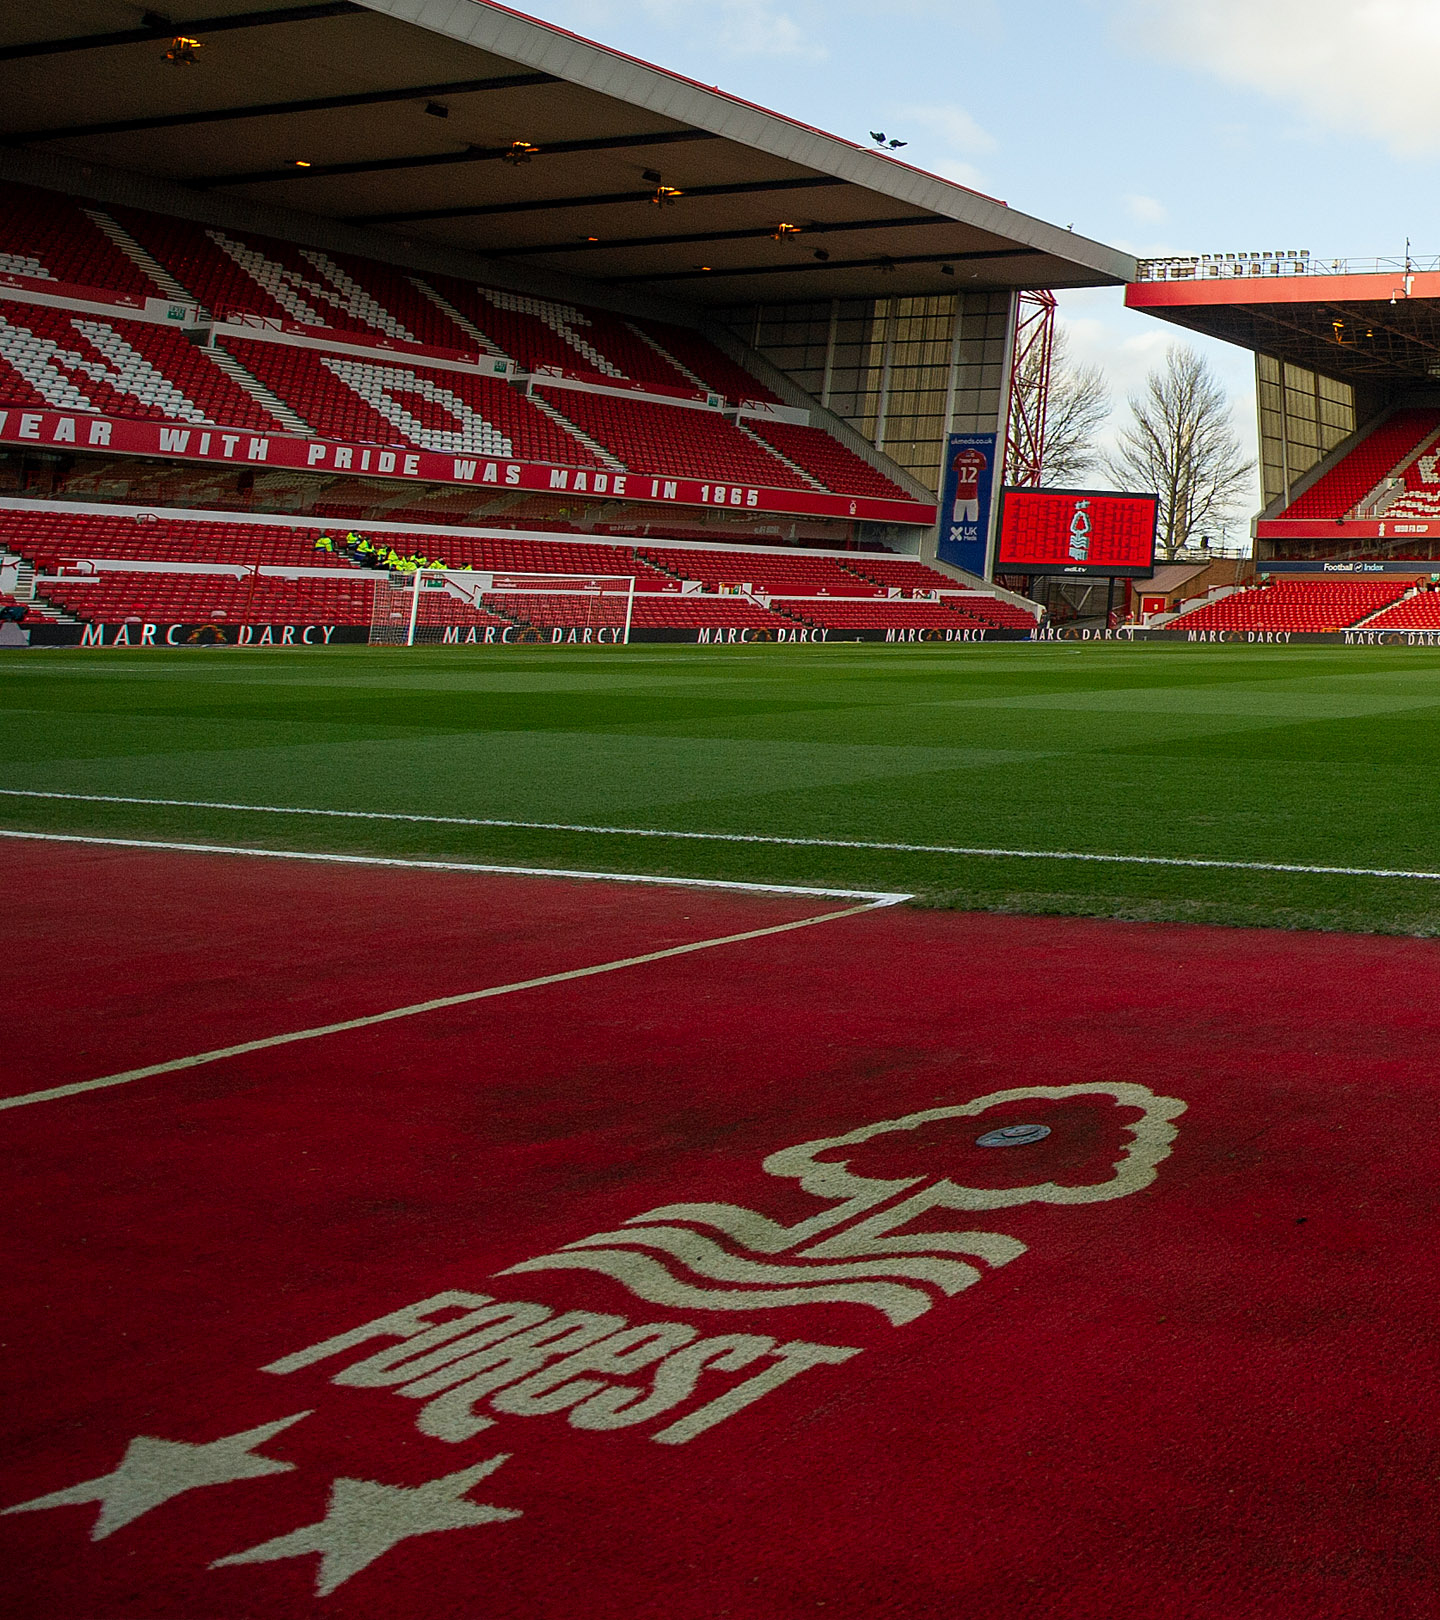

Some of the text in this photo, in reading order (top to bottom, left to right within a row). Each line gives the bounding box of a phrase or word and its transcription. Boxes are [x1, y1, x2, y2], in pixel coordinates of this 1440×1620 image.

[0, 409, 759, 507] EAR WITH PRIDE WAS MADE IN 1865
[960, 466, 978, 484] 12
[964, 526, 978, 536] UK
[1323, 562, 1385, 573] Football Index
[81, 624, 336, 646] MARC DARCY
[442, 626, 622, 644] MARC DARCY
[697, 627, 829, 643] MARC DARCY
[885, 628, 987, 643] MARC DARCY
[1029, 628, 1133, 642] MARC DARCY
[1187, 630, 1292, 644] MARC DARCY
[1344, 631, 1385, 645] MARC
